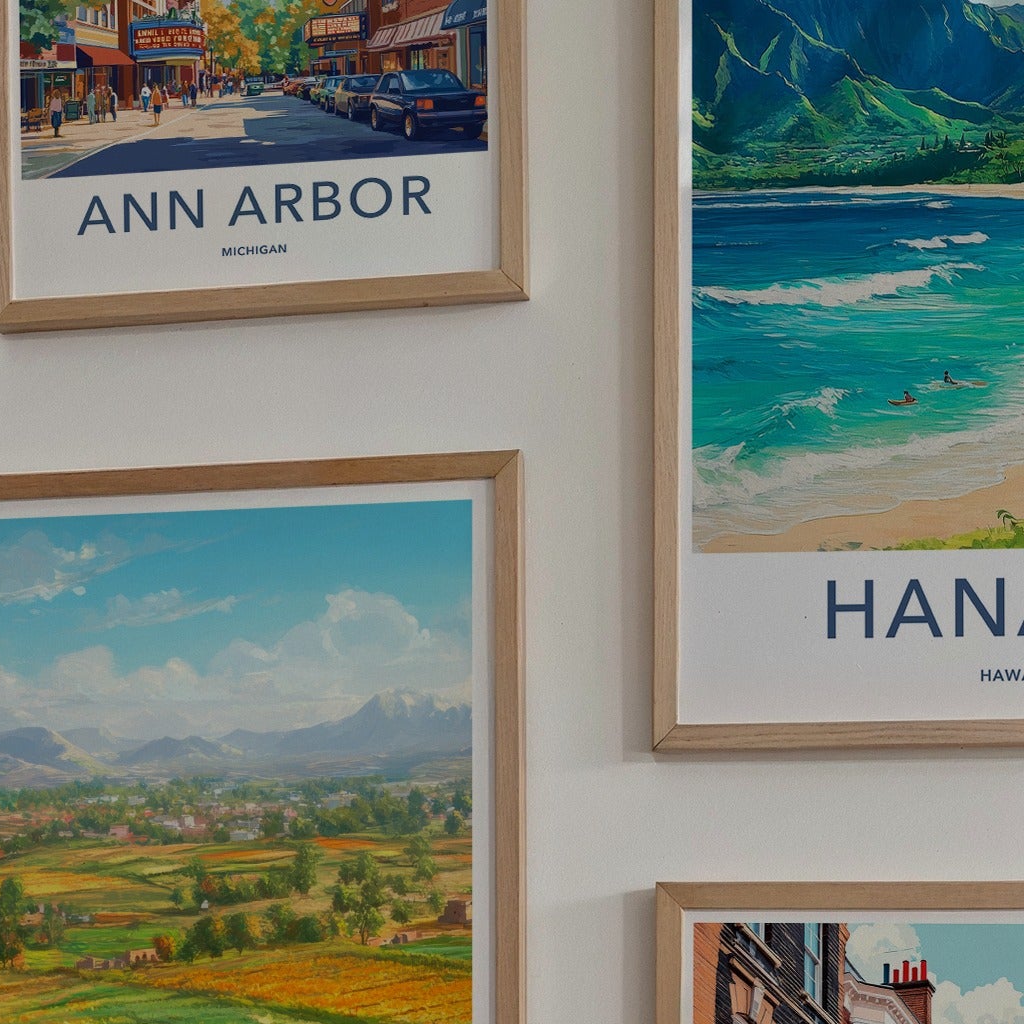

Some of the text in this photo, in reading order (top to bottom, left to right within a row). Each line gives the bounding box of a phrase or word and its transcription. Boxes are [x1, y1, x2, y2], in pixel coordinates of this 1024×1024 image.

[77, 175, 432, 236] ANN ARBOR
[221, 243, 288, 257] MICHIGAN
[827, 577, 1024, 640] HAN
[980, 668, 1024, 682] HAW
